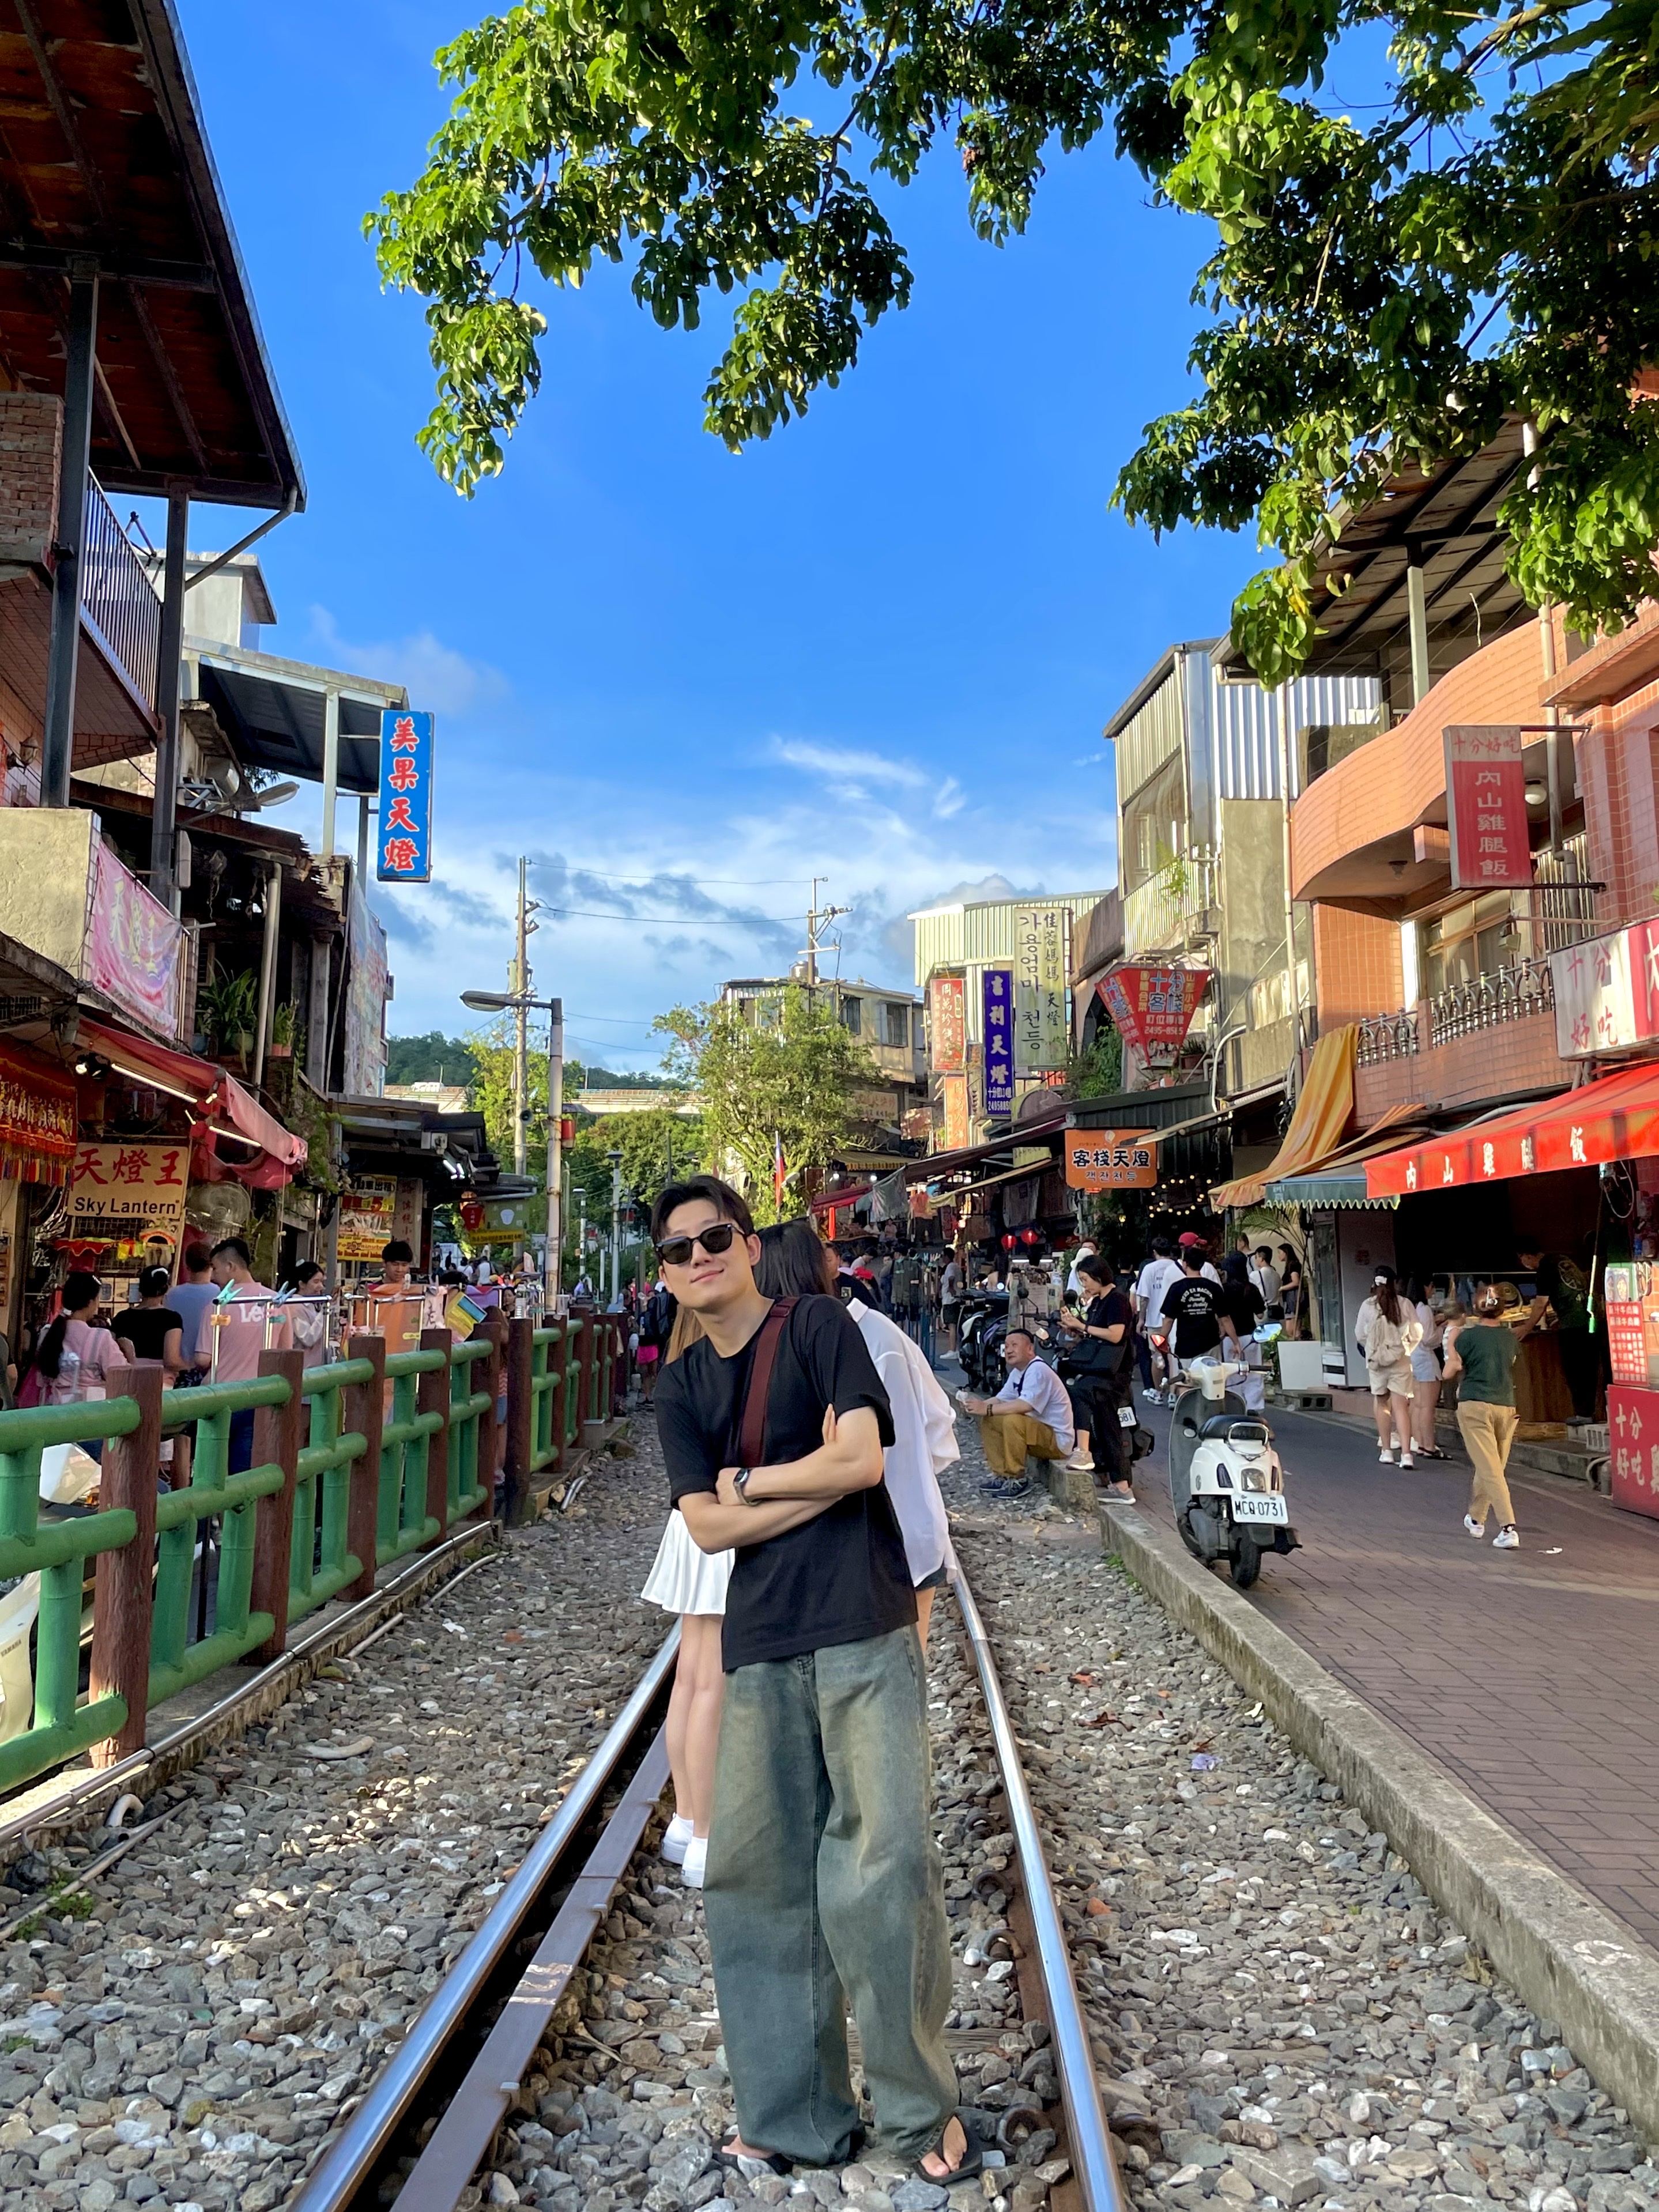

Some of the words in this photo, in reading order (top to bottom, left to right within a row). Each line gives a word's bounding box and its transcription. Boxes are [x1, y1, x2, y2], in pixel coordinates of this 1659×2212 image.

[1453, 734, 1520, 754] 十分好吃
[384, 717, 420, 871] 美果天燈
[1149, 971, 1186, 994] 十分
[1566, 939, 1612, 991] 十分
[1047, 991, 1061, 1026] 天燈
[1021, 1009, 1045, 1050] 천등
[1570, 1005, 1618, 1051] 好吃
[74, 1147, 183, 1186] 天燈王
[1072, 1149, 1151, 1168] 客棧天燈
[74, 1196, 106, 1216] Sky
[110, 1198, 176, 1214] Lantern
[239, 1303, 265, 1323] Le
[1615, 1403, 1642, 1440] 十分
[1616, 1448, 1645, 1486] 好吃
